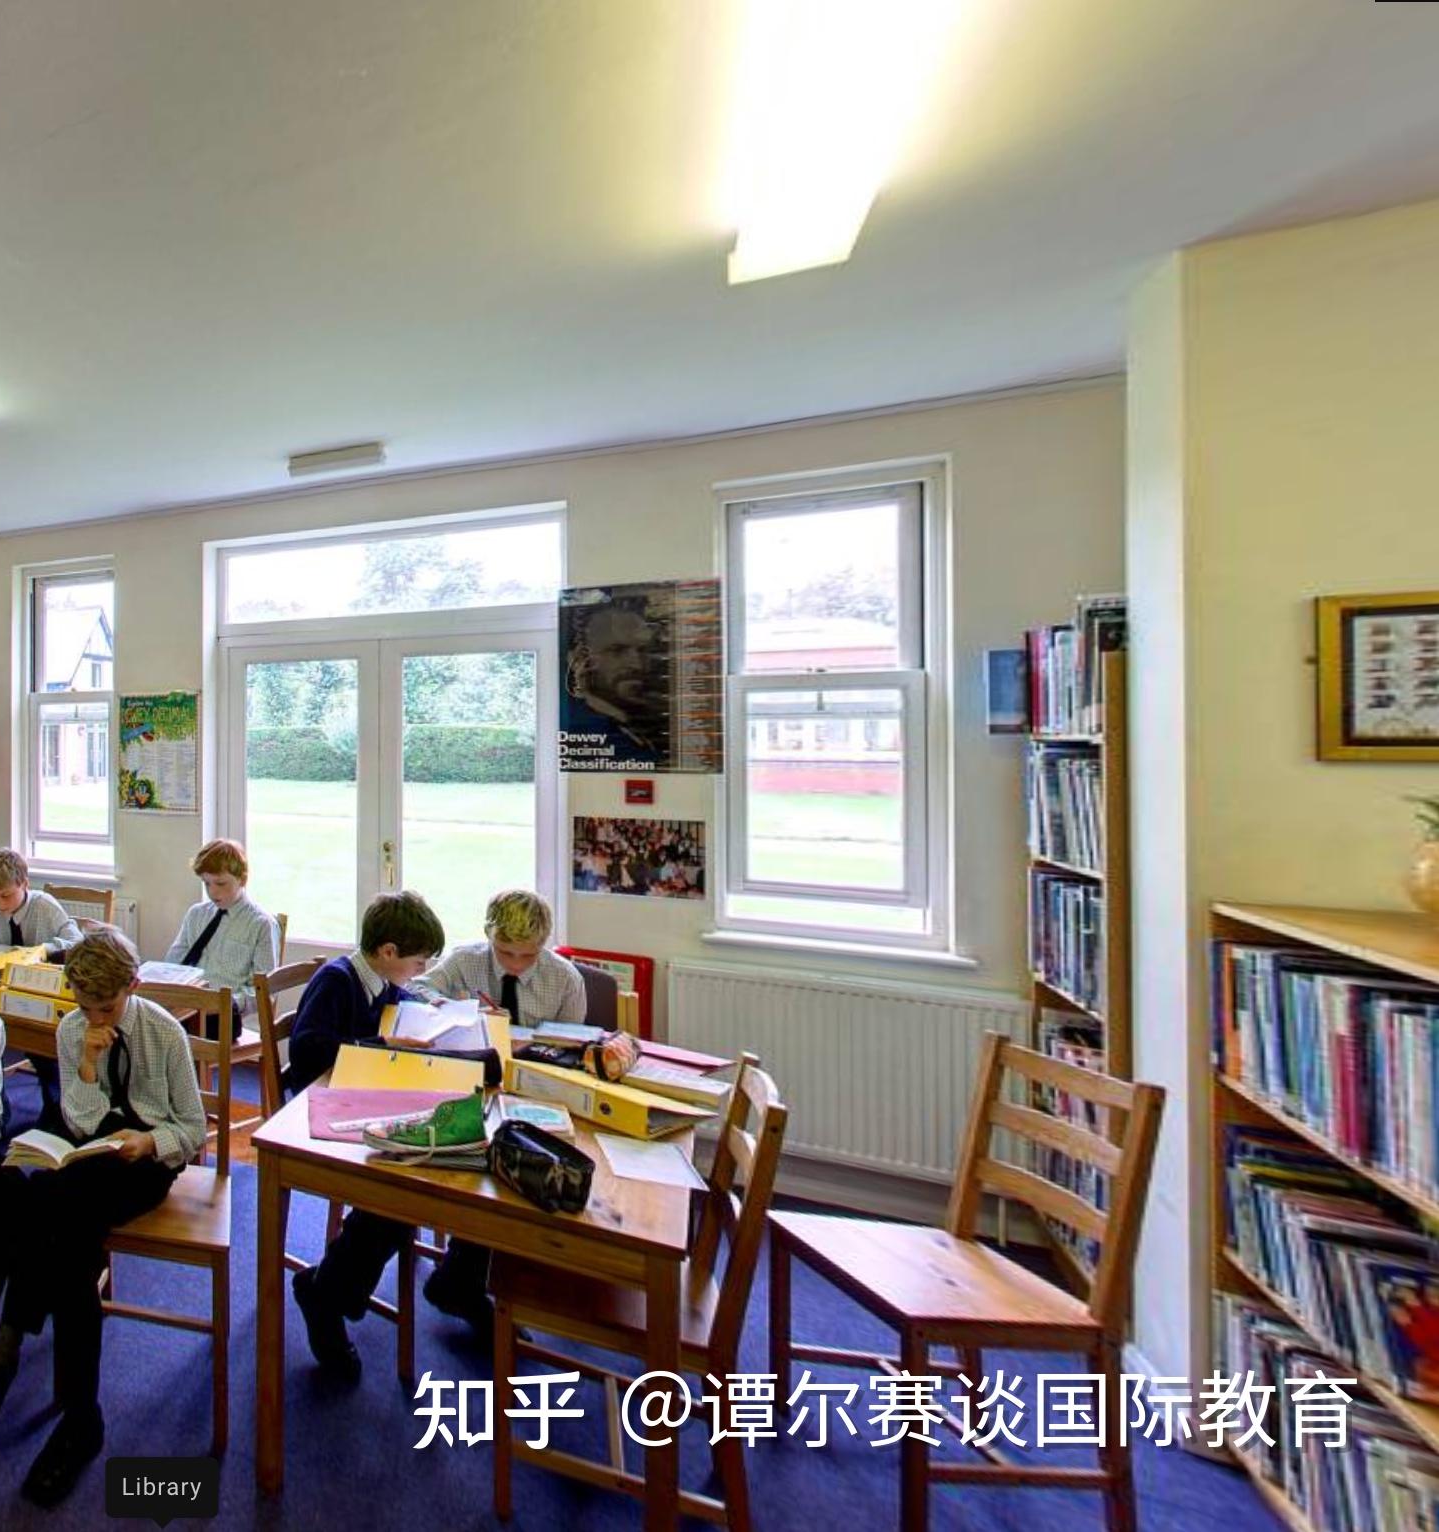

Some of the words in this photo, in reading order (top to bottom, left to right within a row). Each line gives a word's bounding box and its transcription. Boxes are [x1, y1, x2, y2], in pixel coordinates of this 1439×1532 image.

[557, 731, 607, 745] Dewey
[557, 744, 615, 756] Decimal
[557, 758, 655, 770] Classification
